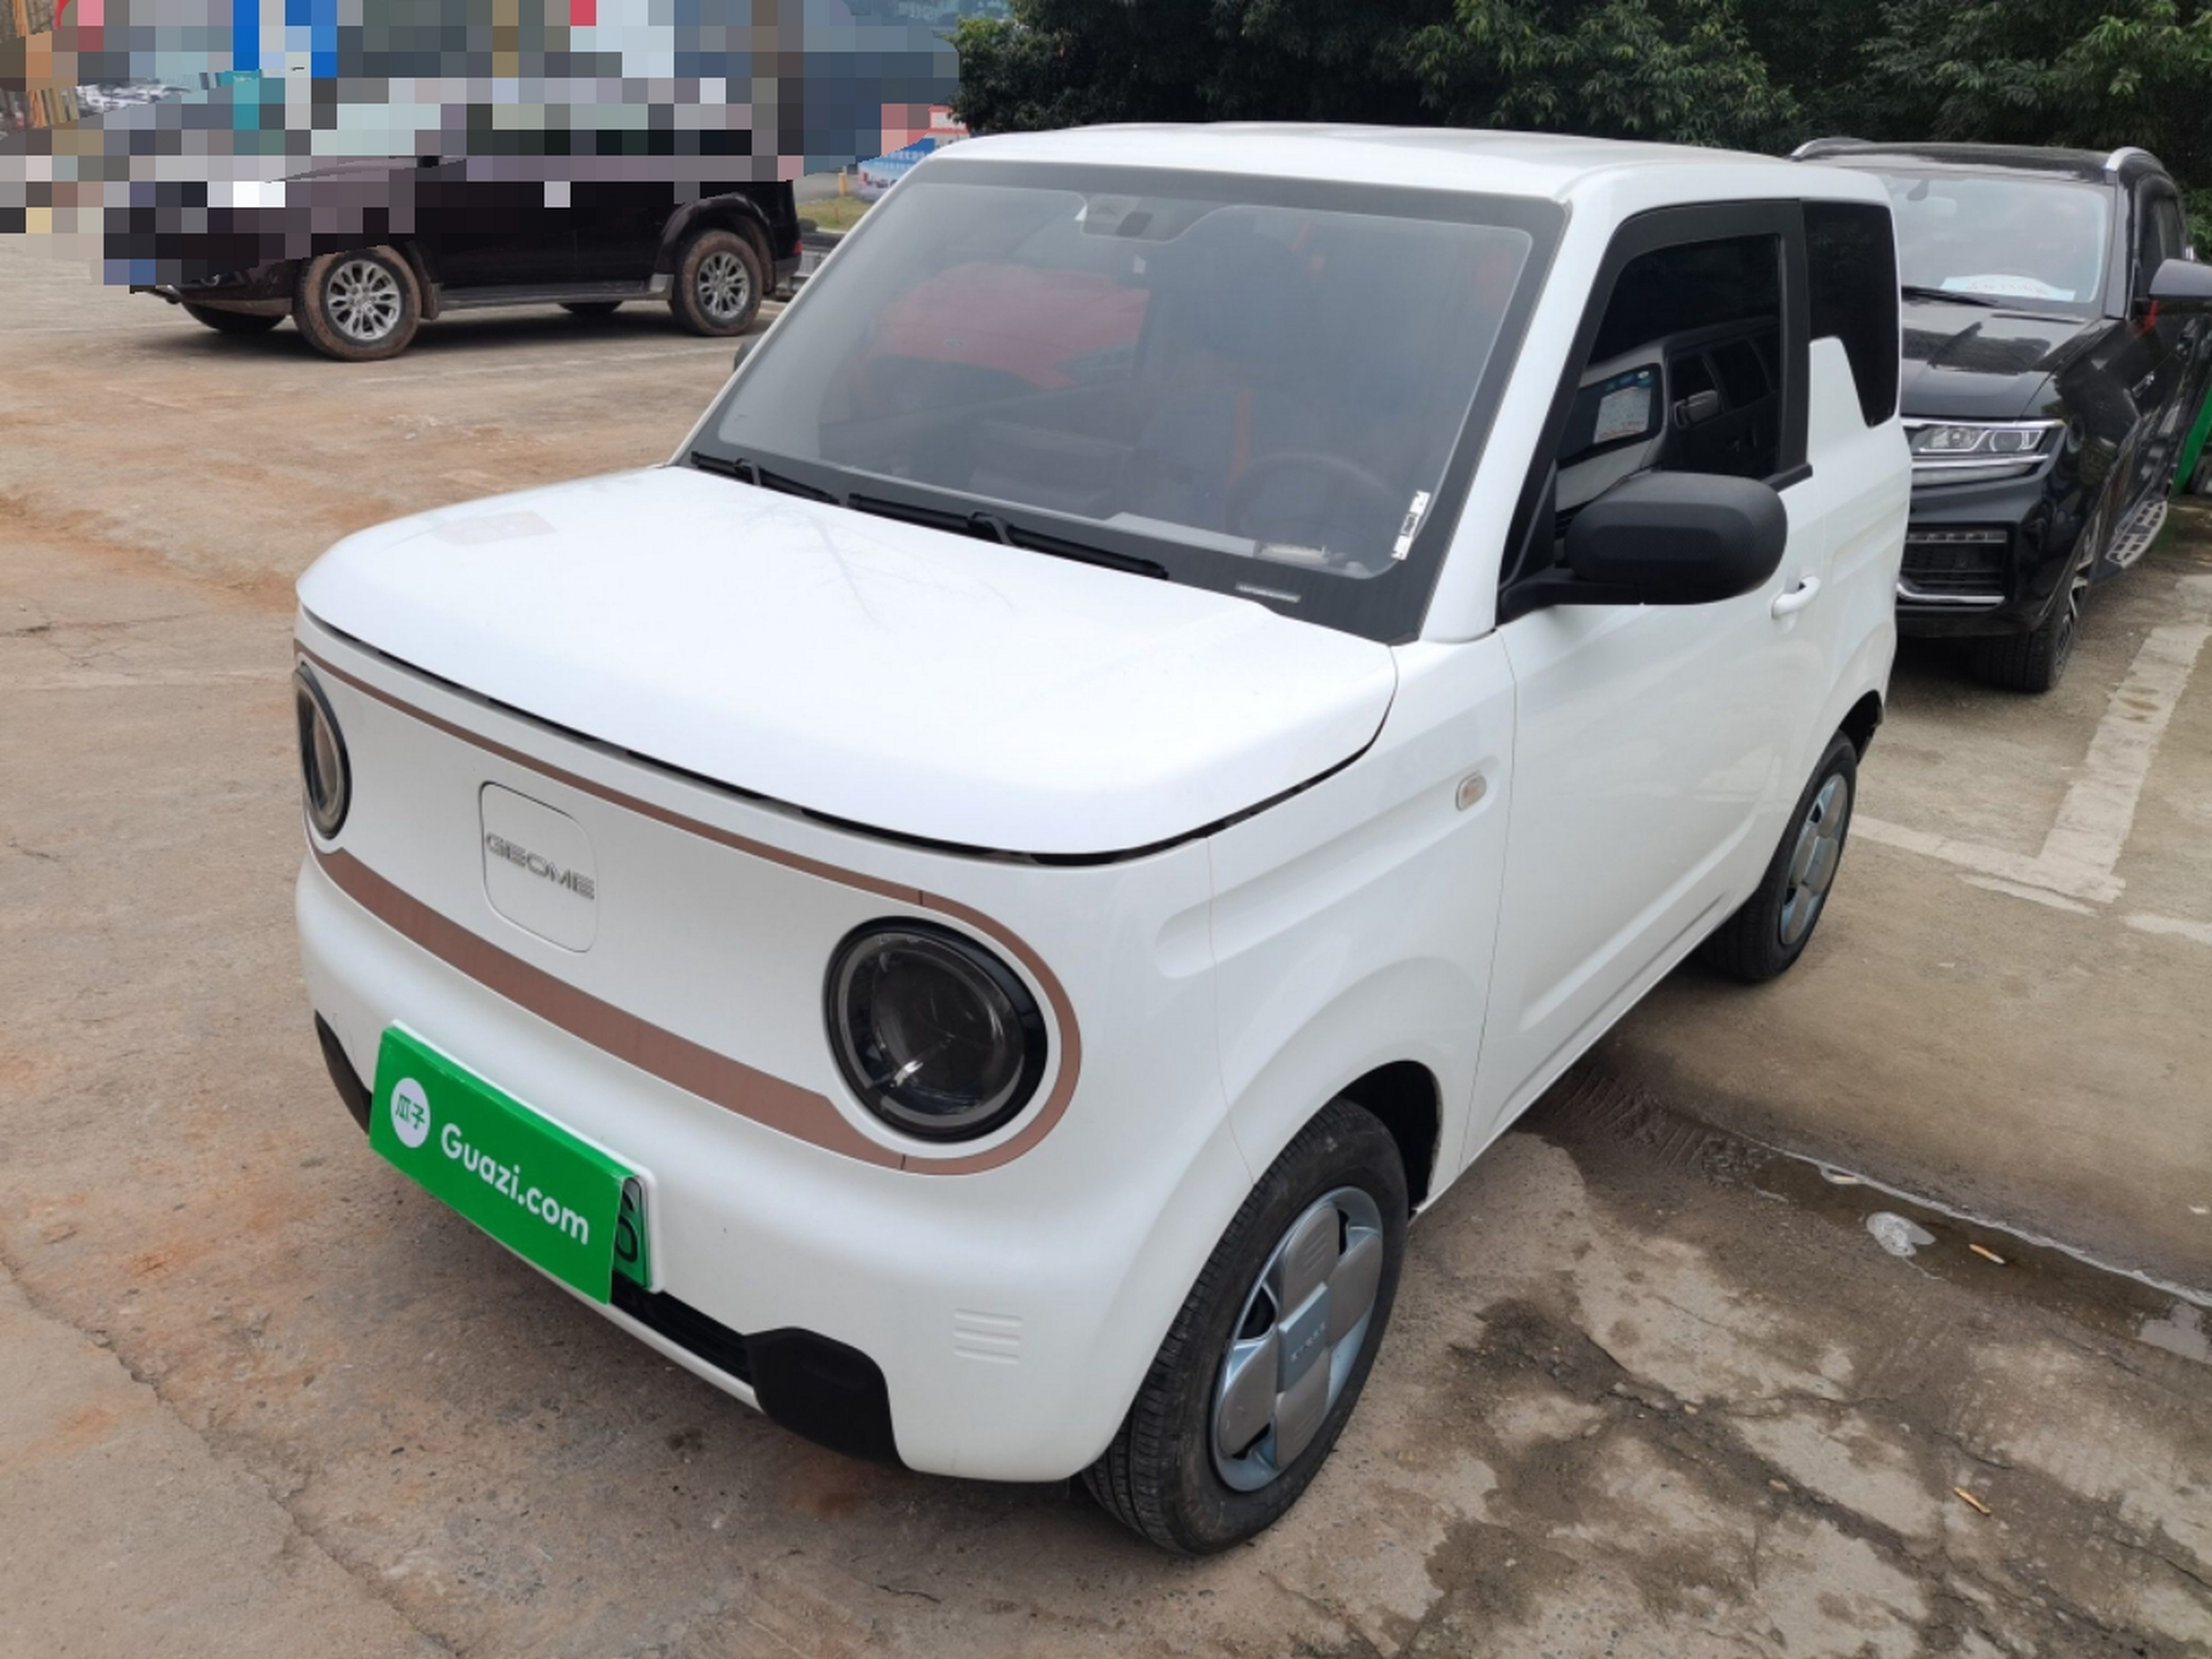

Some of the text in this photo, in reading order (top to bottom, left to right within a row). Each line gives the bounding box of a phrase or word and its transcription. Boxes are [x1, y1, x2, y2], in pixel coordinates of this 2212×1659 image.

[486, 832, 594, 900] GEOME
[395, 1093, 426, 1130] 瓜子
[441, 1123, 589, 1245] Guazi.com
